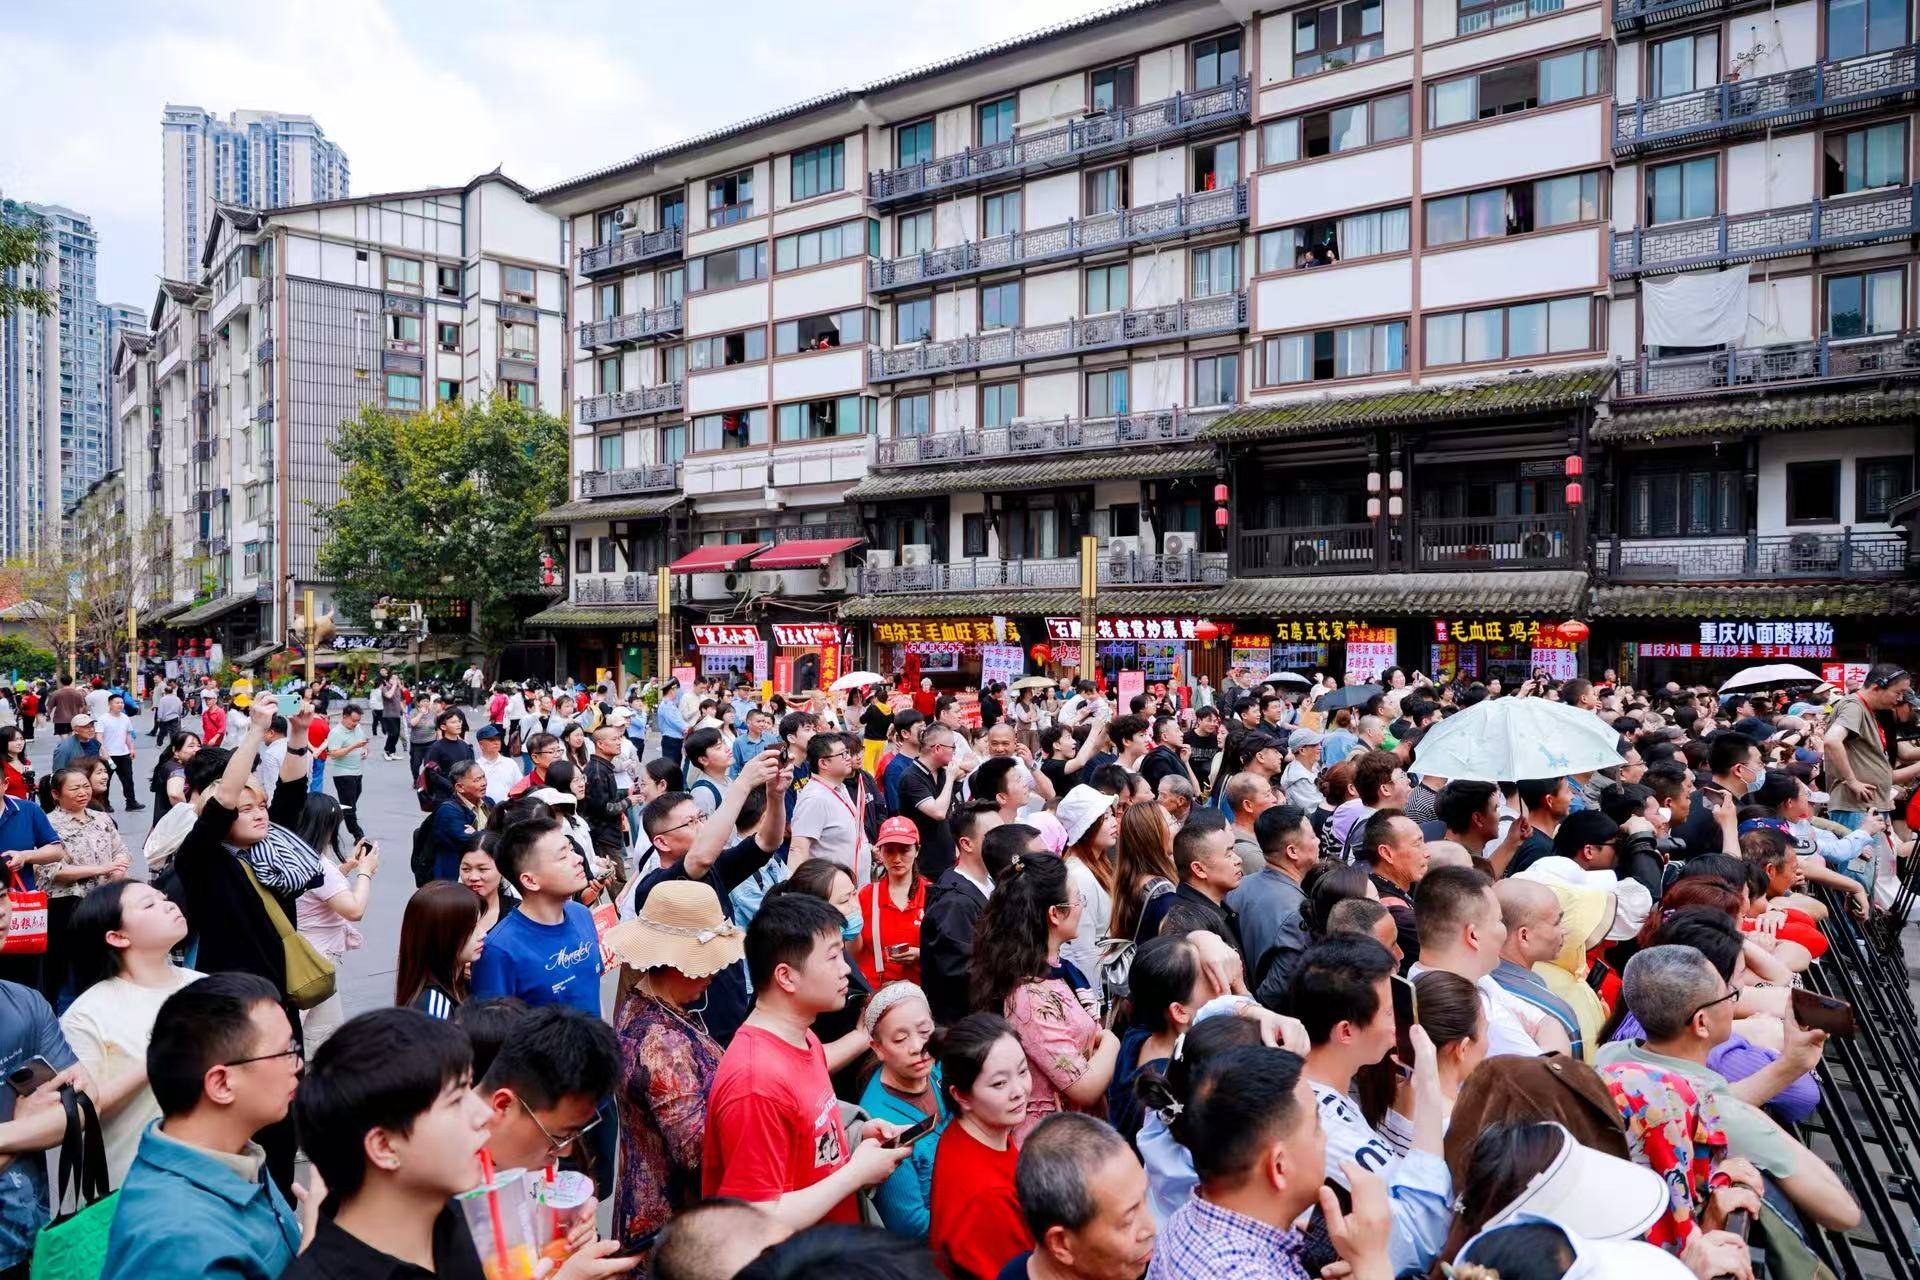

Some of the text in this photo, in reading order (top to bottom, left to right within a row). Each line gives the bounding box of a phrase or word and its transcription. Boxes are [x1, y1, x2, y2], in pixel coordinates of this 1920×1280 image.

[878, 622, 923, 641] 鸡杂王
[925, 622, 973, 641] 毛血旺
[1349, 629, 1385, 642] 十年老店
[1451, 620, 1504, 642] 毛血旺
[1699, 622, 1834, 644] 重庆小面酸辣粉
[1232, 635, 1270, 647] 十年老店
[1534, 636, 1568, 649] 十年老
[1640, 644, 1832, 658] 重庆小面 老麻抄手 手工酸辣粉
